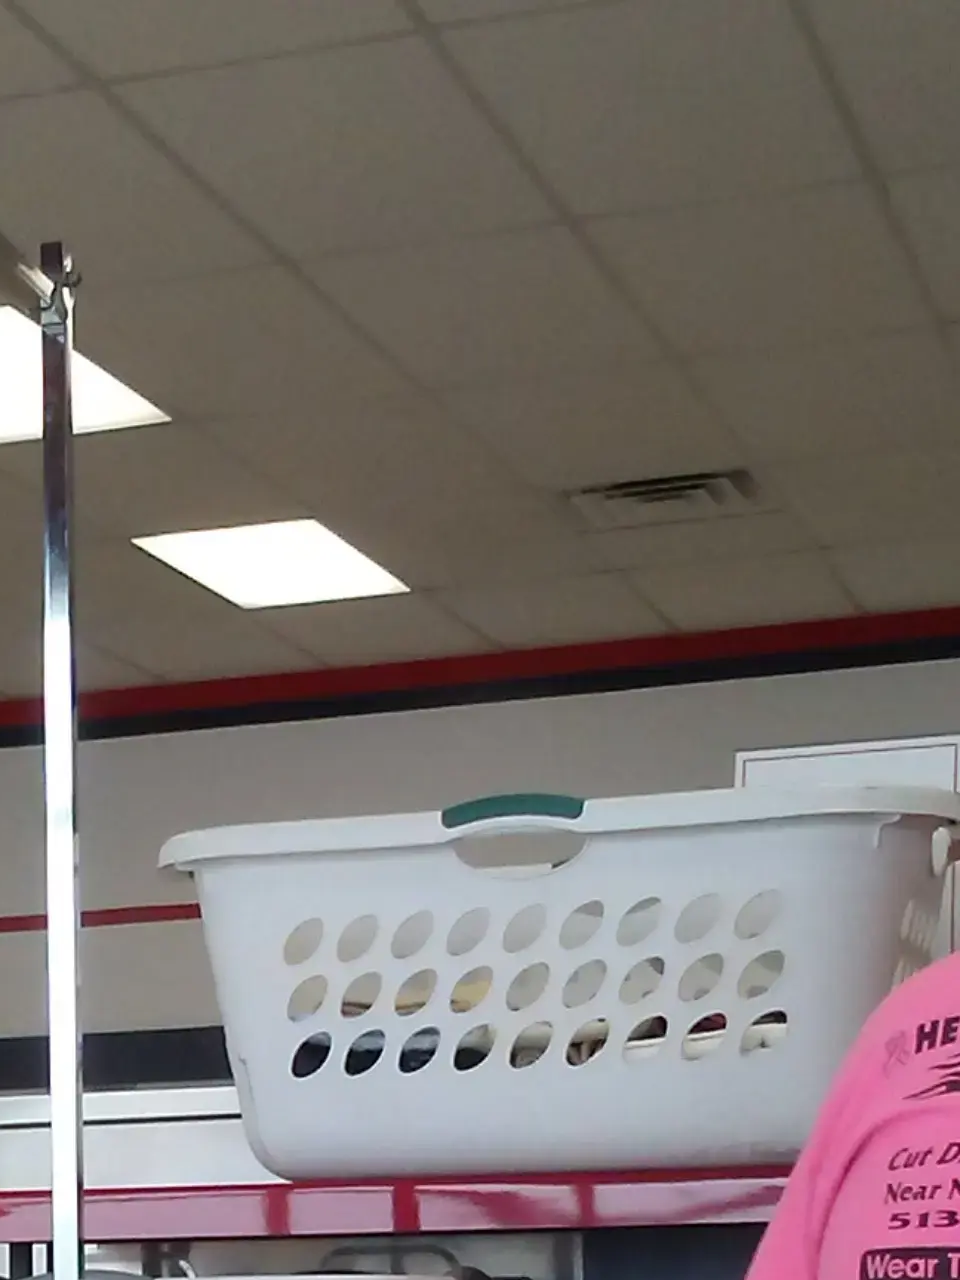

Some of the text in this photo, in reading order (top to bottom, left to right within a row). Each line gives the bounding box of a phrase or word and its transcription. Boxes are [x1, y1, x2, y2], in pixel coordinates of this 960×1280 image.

[887, 1146, 934, 1172] Cut
[884, 1181, 942, 1205] Near
[866, 1253, 940, 1280] Wear
